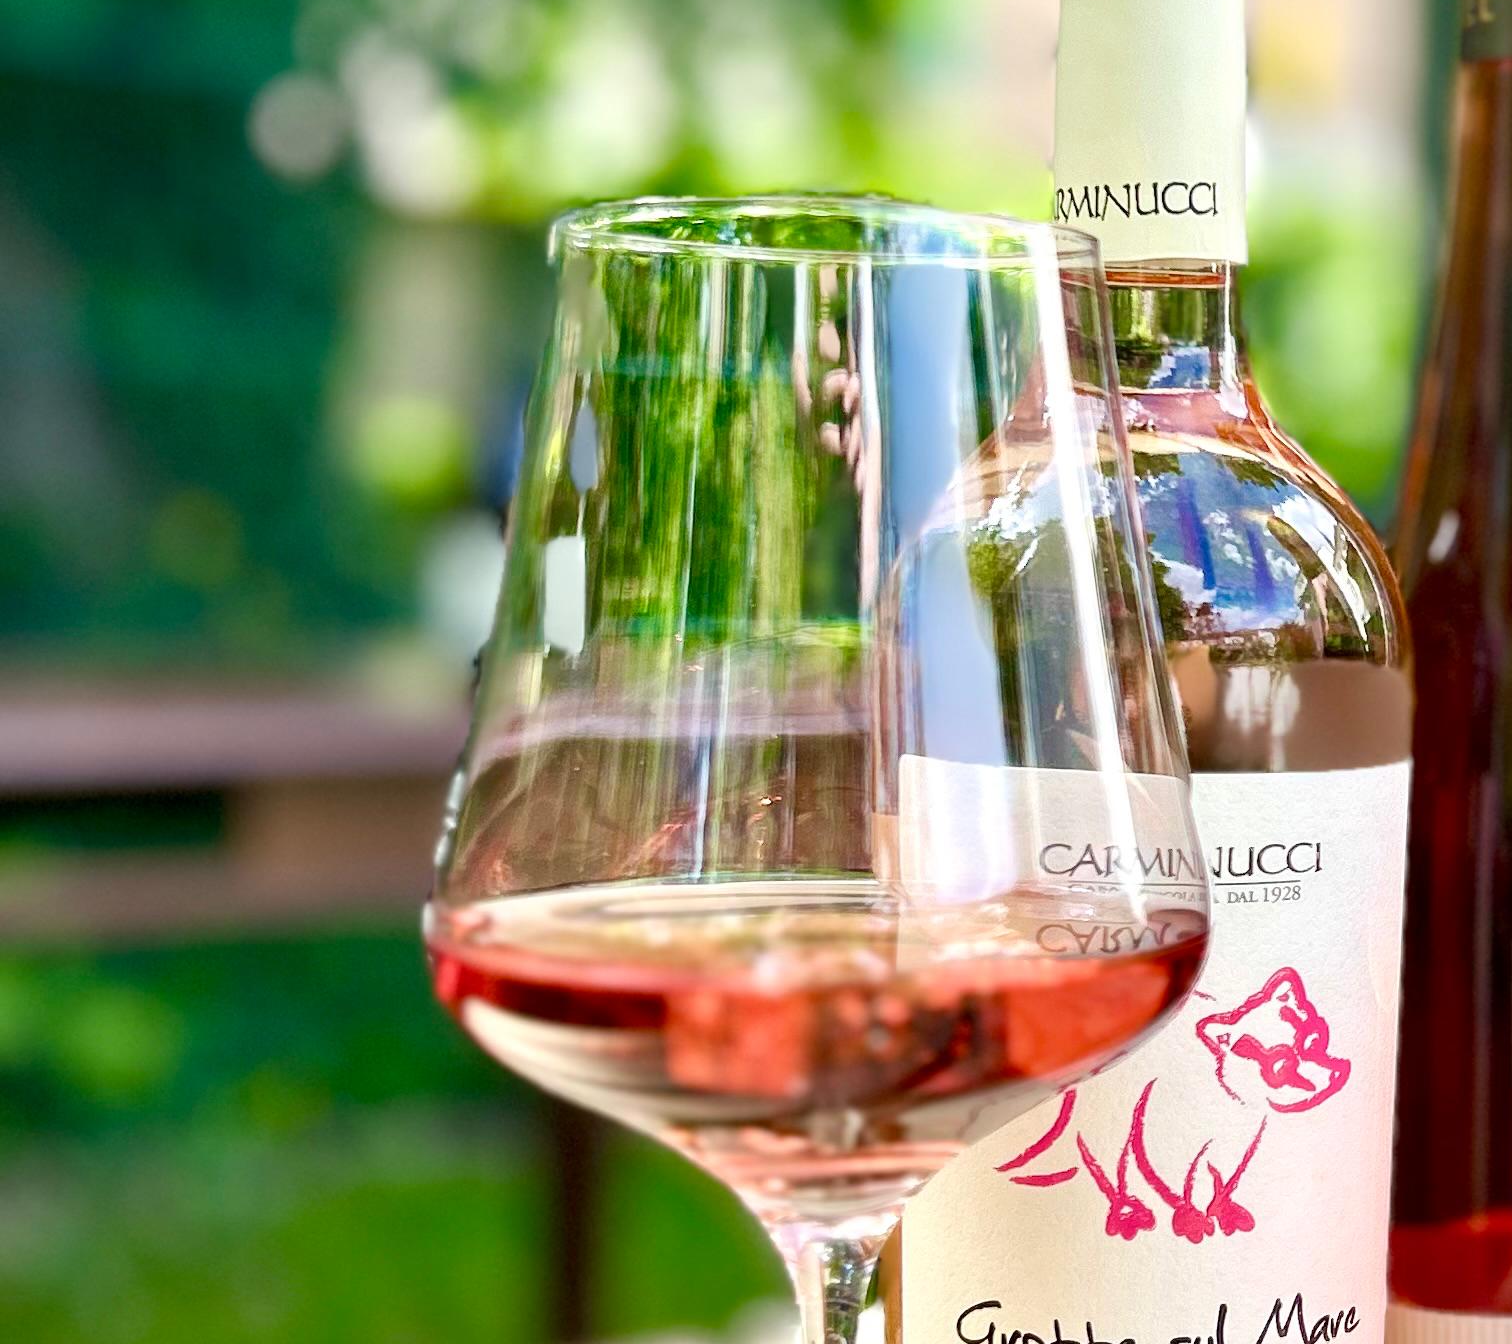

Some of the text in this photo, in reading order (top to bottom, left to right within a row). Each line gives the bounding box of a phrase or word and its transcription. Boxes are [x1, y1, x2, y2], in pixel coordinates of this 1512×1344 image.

[1039, 841, 1323, 877] CARMINUCCI
[1226, 891, 1258, 904] DAL
[1263, 885, 1302, 903] 1928
